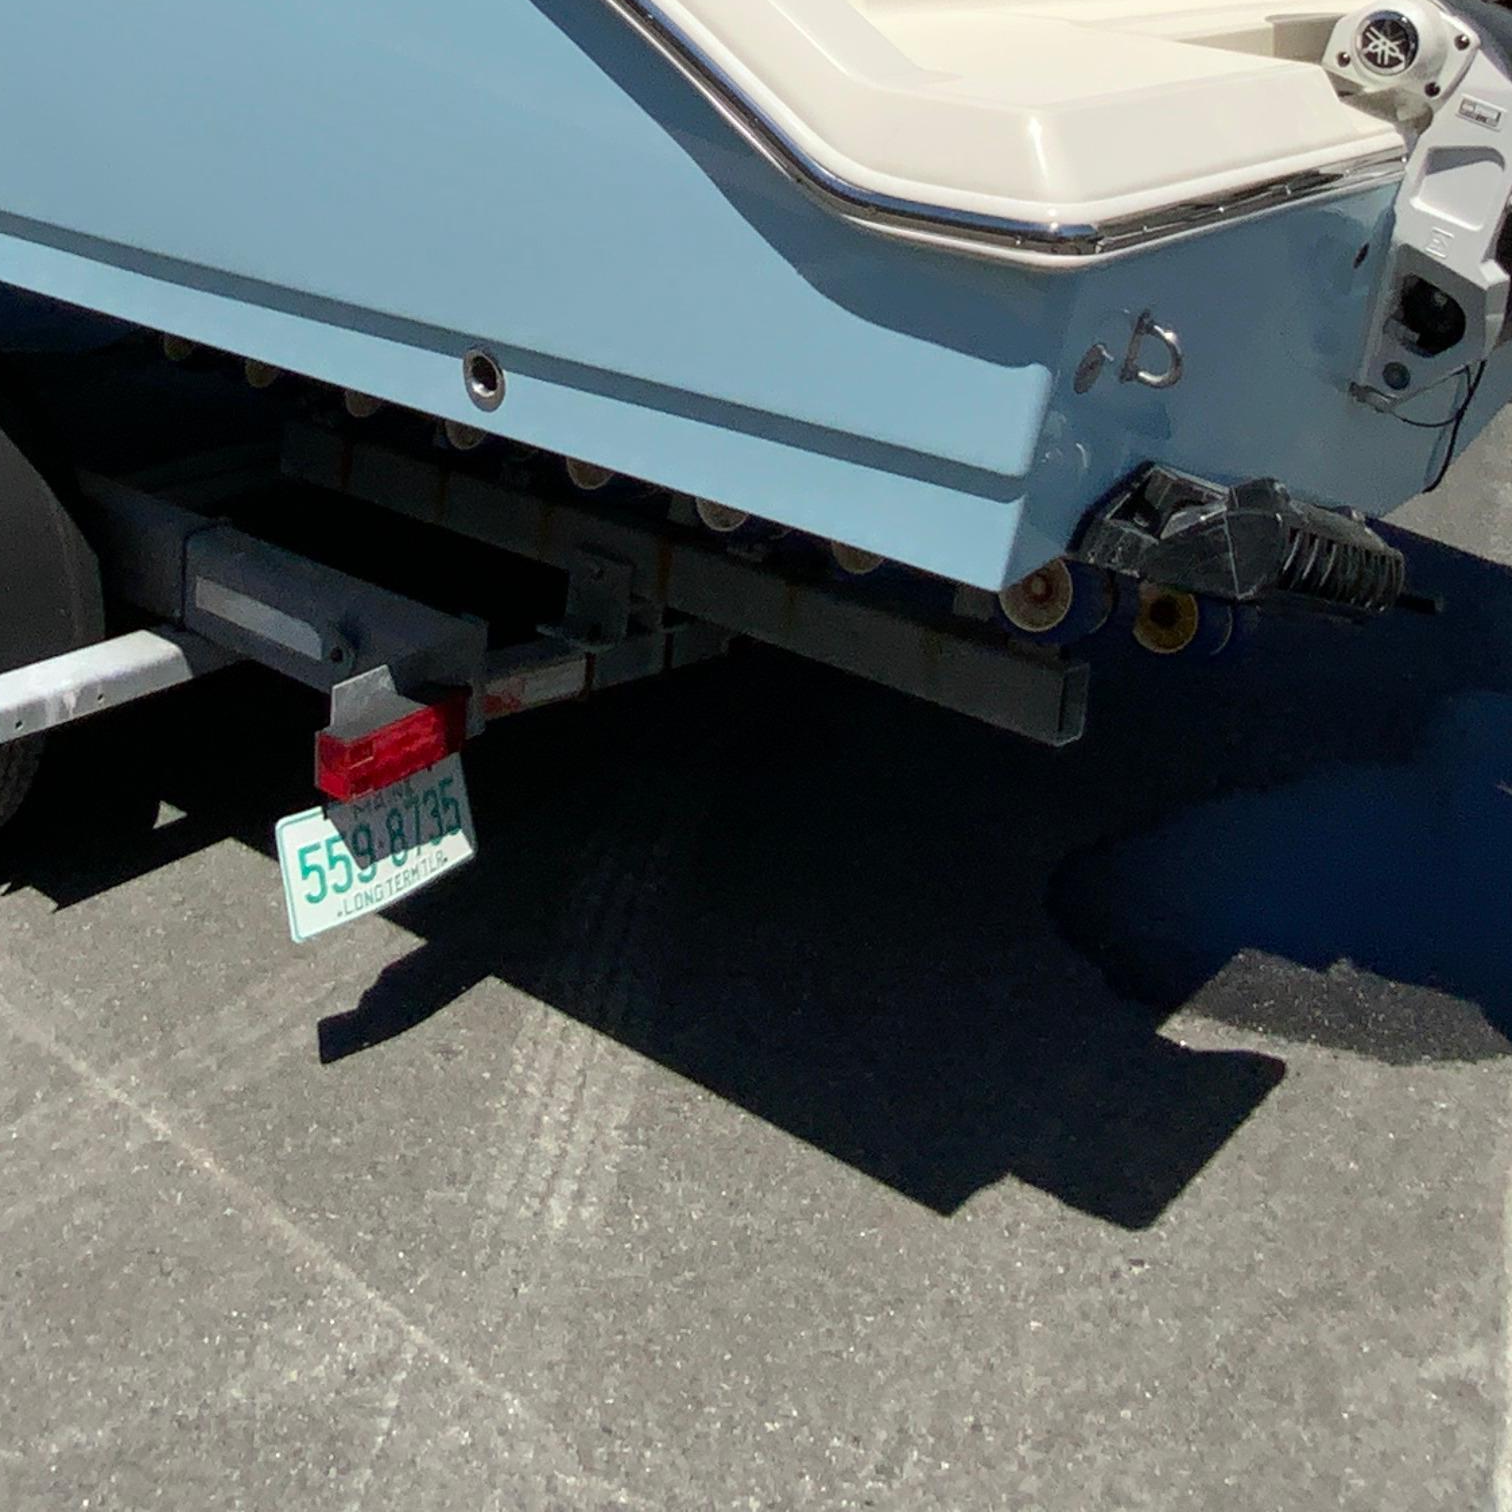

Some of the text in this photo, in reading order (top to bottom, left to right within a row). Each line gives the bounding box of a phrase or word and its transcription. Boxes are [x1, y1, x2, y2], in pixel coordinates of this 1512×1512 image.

[297, 822, 376, 904] 559
[342, 883, 385, 916] LONG
[386, 865, 420, 896] TERM
